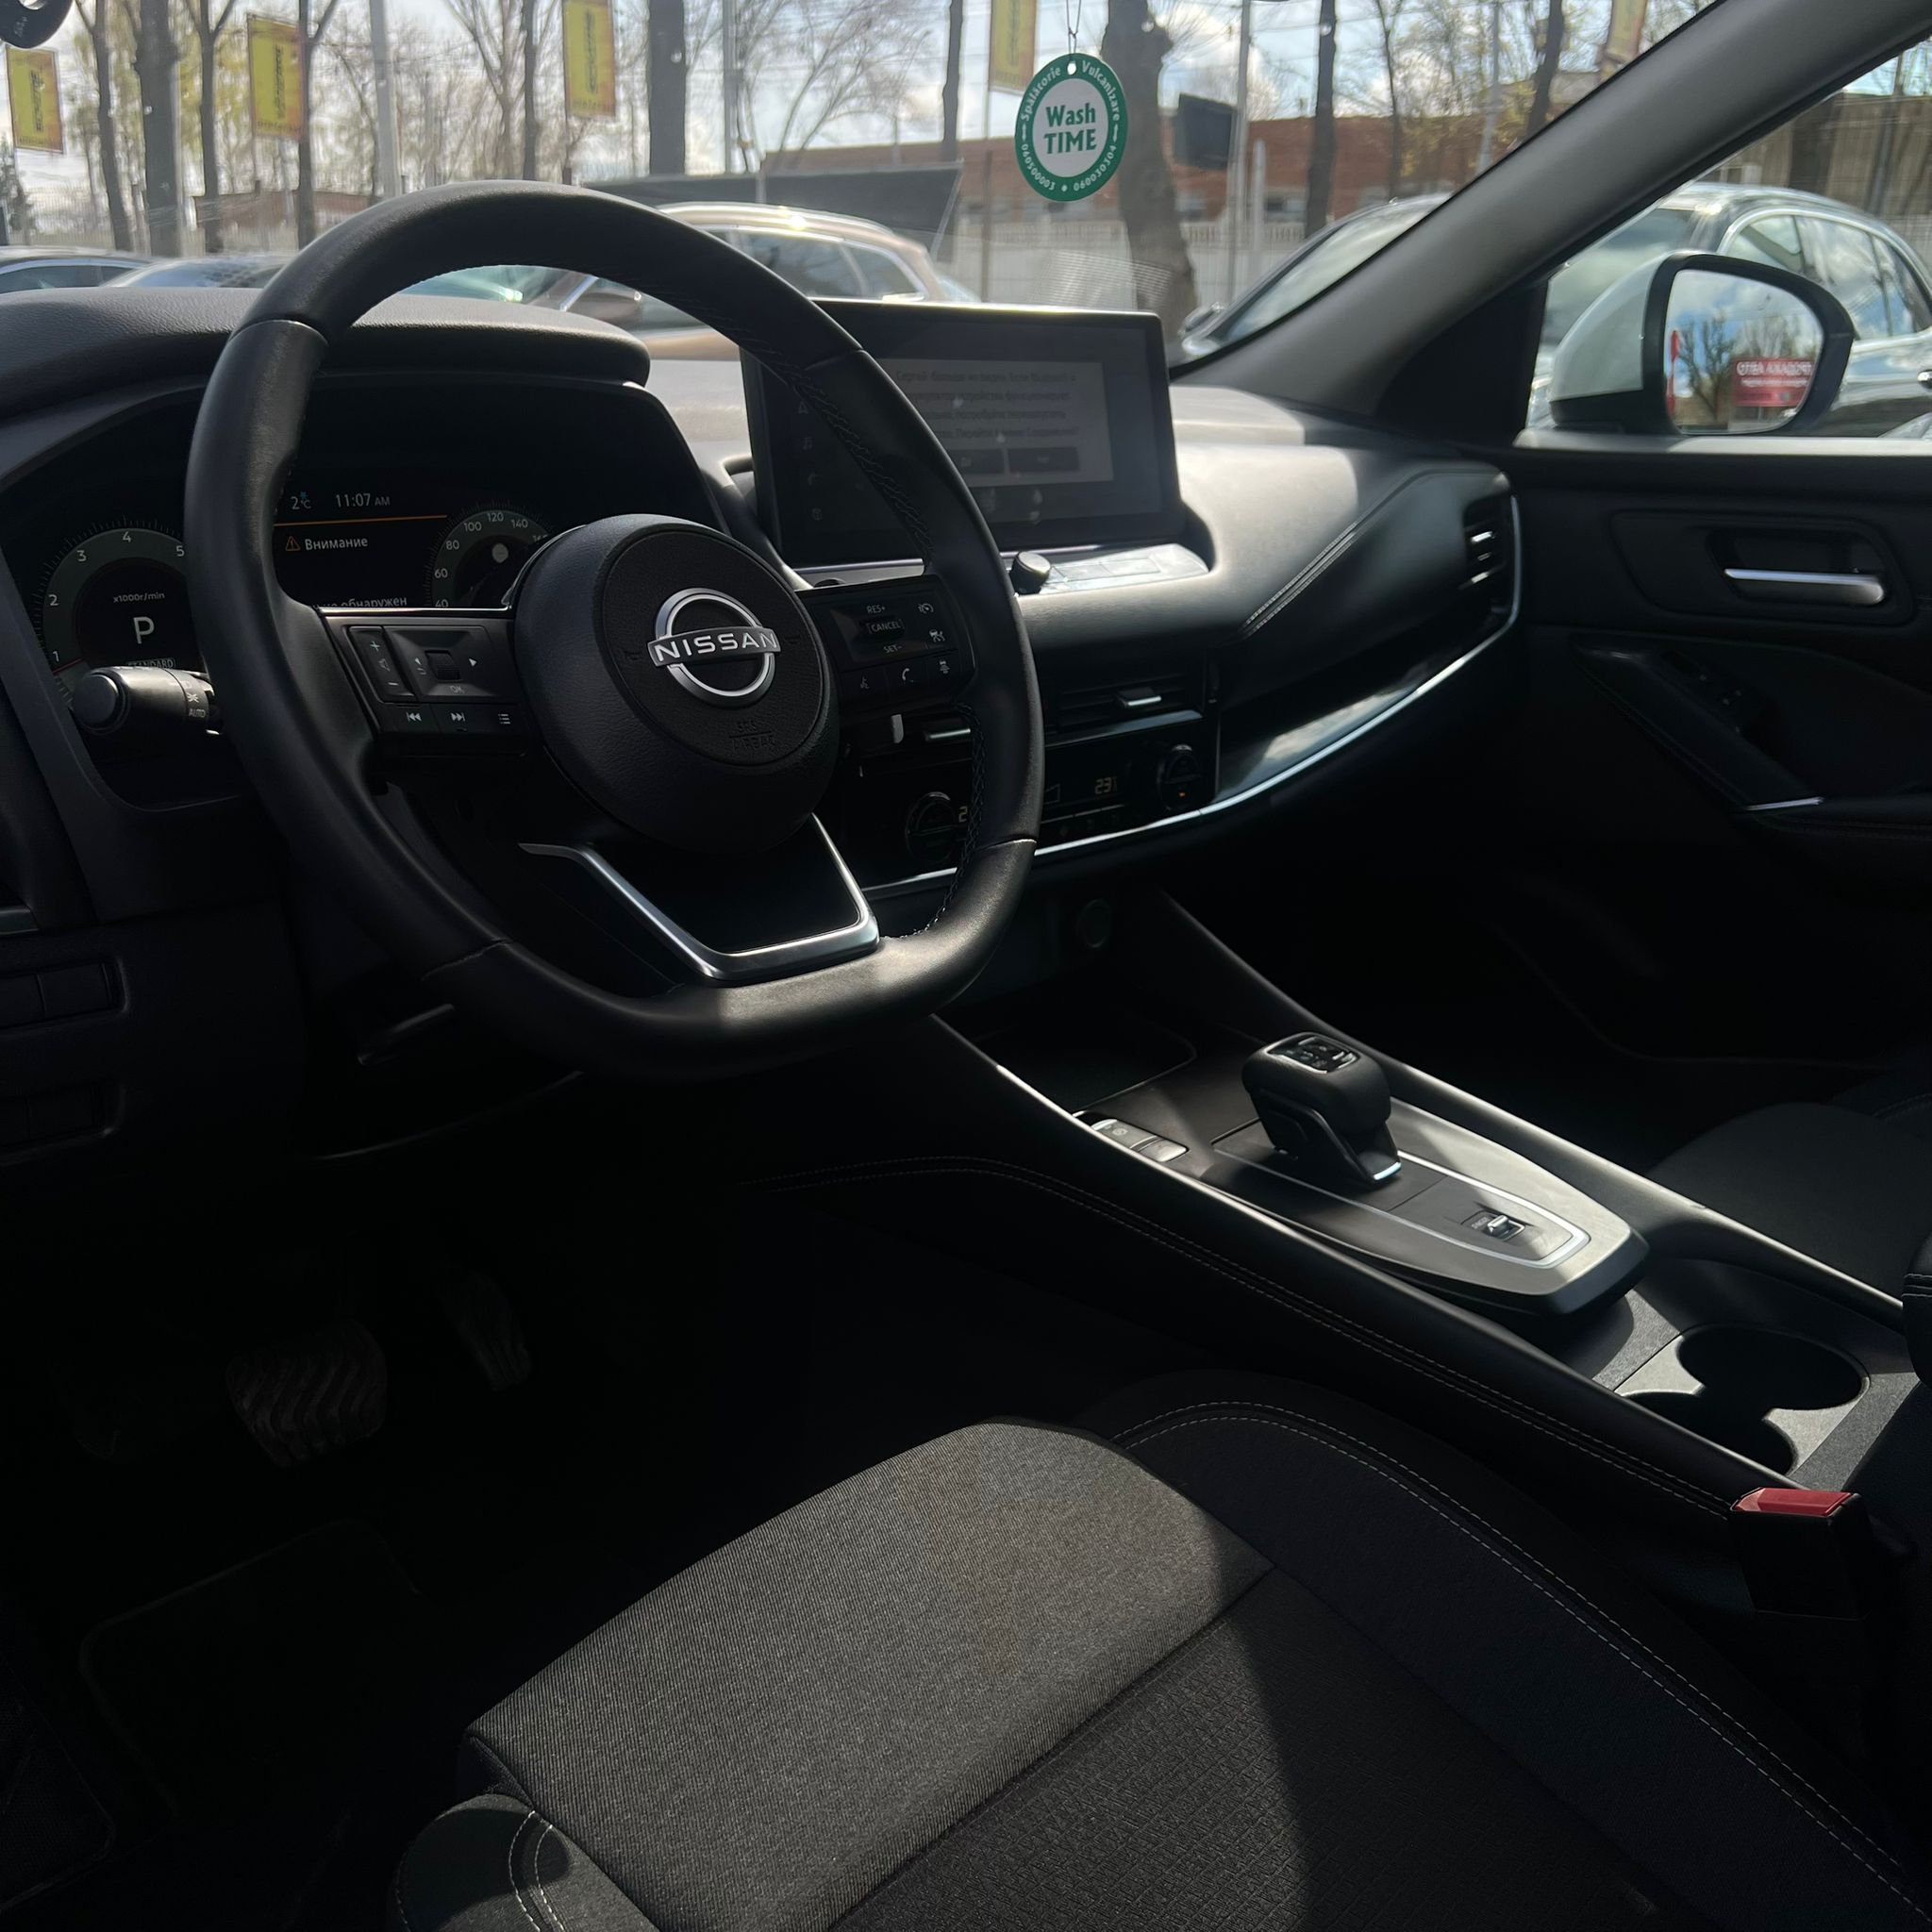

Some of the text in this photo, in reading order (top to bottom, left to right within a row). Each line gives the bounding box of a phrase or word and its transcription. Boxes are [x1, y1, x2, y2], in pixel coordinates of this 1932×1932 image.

[1082, 60, 1121, 121] Vulcanizare
[1045, 102, 1096, 127] Wash
[1043, 128, 1097, 154] TIME
[335, 492, 371, 508] 11:07
[375, 498, 391, 507] AM
[487, 512, 504, 523] 120
[510, 518, 528, 529] 140
[463, 522, 482, 532] 100
[122, 531, 132, 542] 4
[304, 537, 369, 551] Внимание
[445, 540, 460, 550] 80
[76, 549, 87, 562] 3
[175, 545, 185, 558] 5
[434, 568, 448, 579] 60
[48, 594, 58, 607] 2
[435, 598, 449, 608] 40
[133, 616, 156, 644] P
[870, 621, 903, 633] CANCEL
[654, 632, 777, 662] NISSAN
[52, 651, 60, 662] 1
